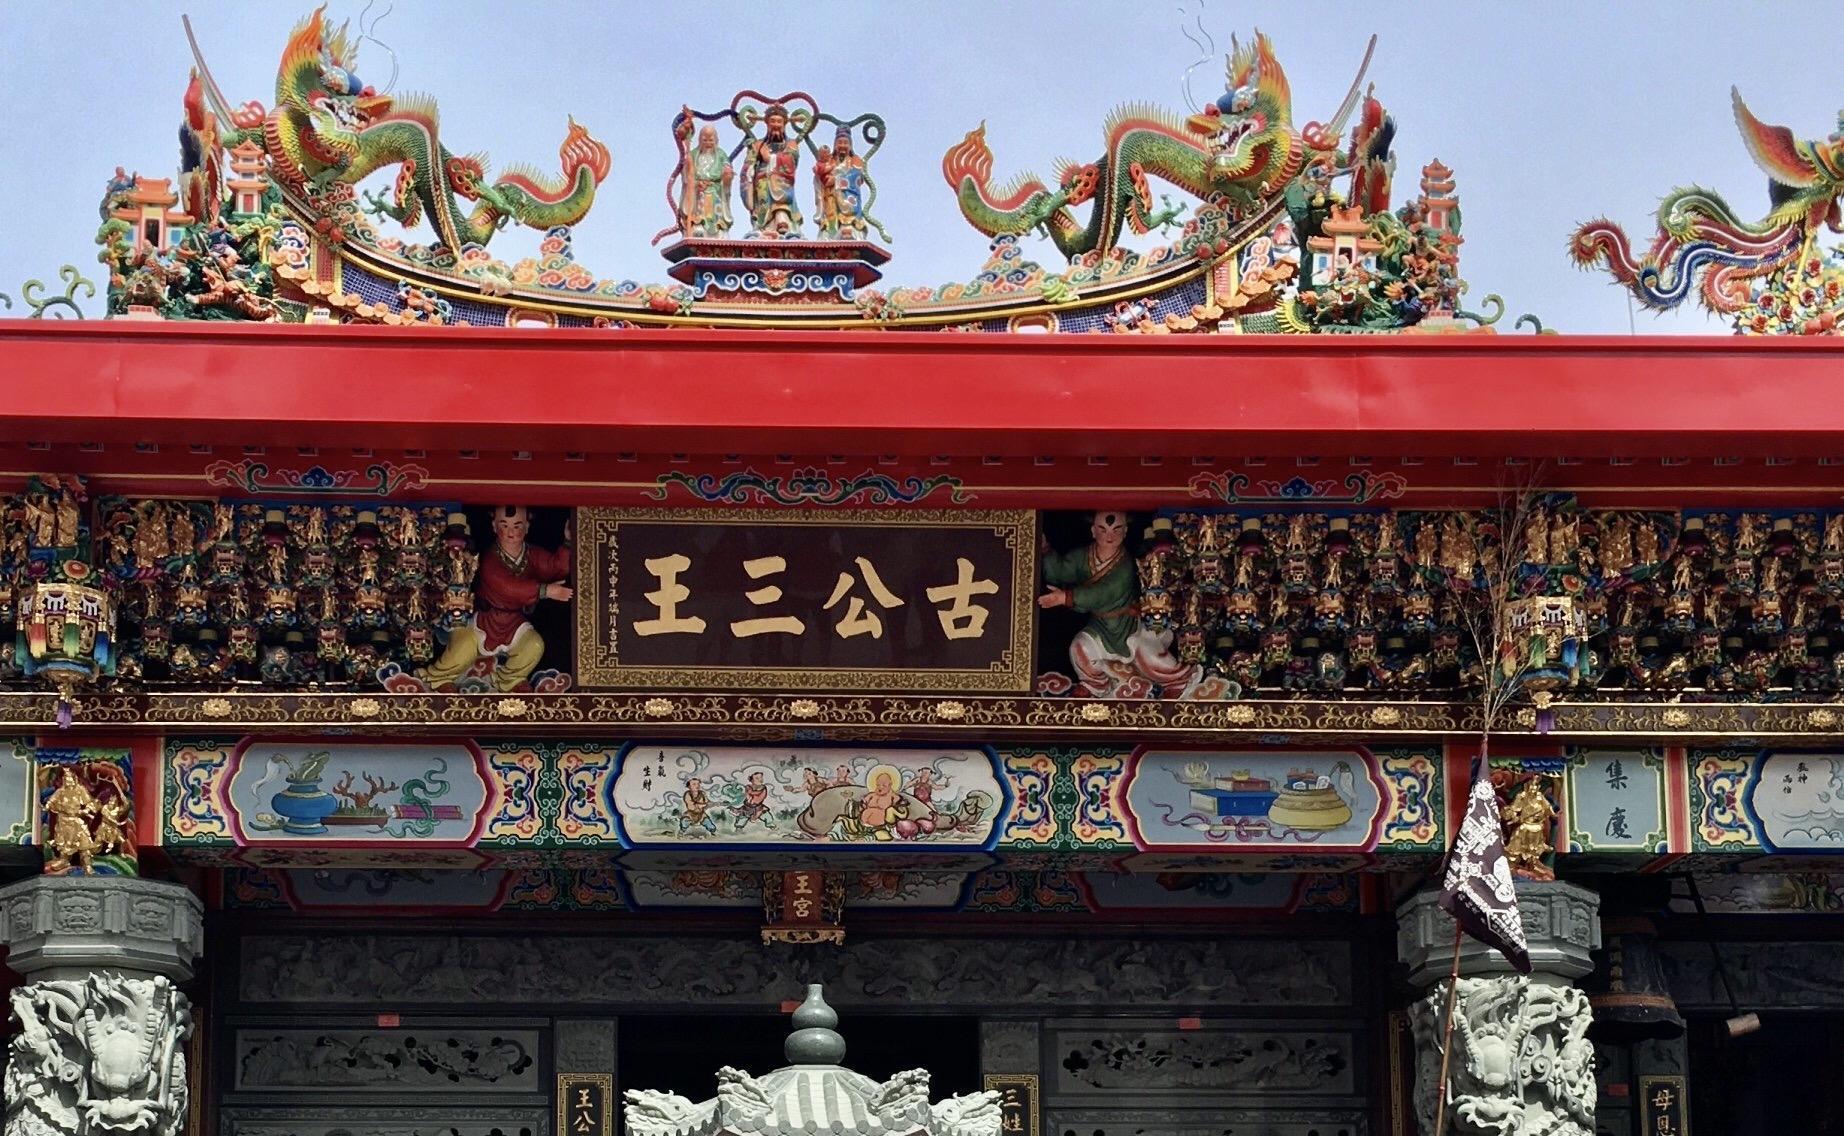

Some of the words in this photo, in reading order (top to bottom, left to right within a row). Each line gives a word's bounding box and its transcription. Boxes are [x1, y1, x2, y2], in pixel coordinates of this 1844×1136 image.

[633, 554, 999, 640] 古公三王
[1604, 760, 1633, 841] 集慶
[793, 871, 813, 918] 王宮
